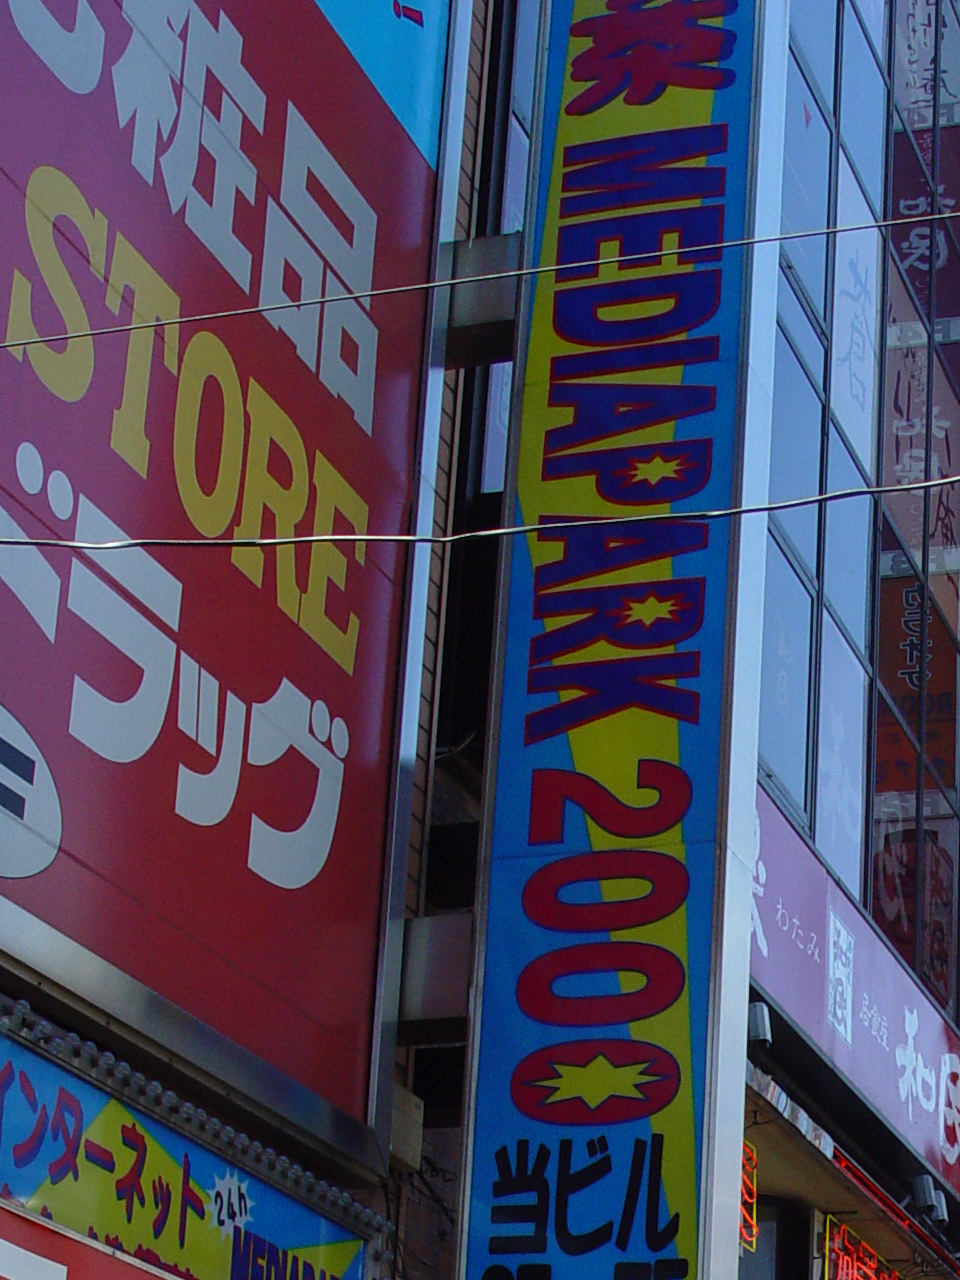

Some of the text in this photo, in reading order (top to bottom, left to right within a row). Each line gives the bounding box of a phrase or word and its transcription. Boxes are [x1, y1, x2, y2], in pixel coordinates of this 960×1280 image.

[10, 164, 369, 678] STORE
[510, 121, 730, 1126] MEDIAPARK 2000
[775, 896, 821, 964] わたみ
[213, 1183, 250, 1229] 24h
[487, 1132, 682, 1257] 当ビル
